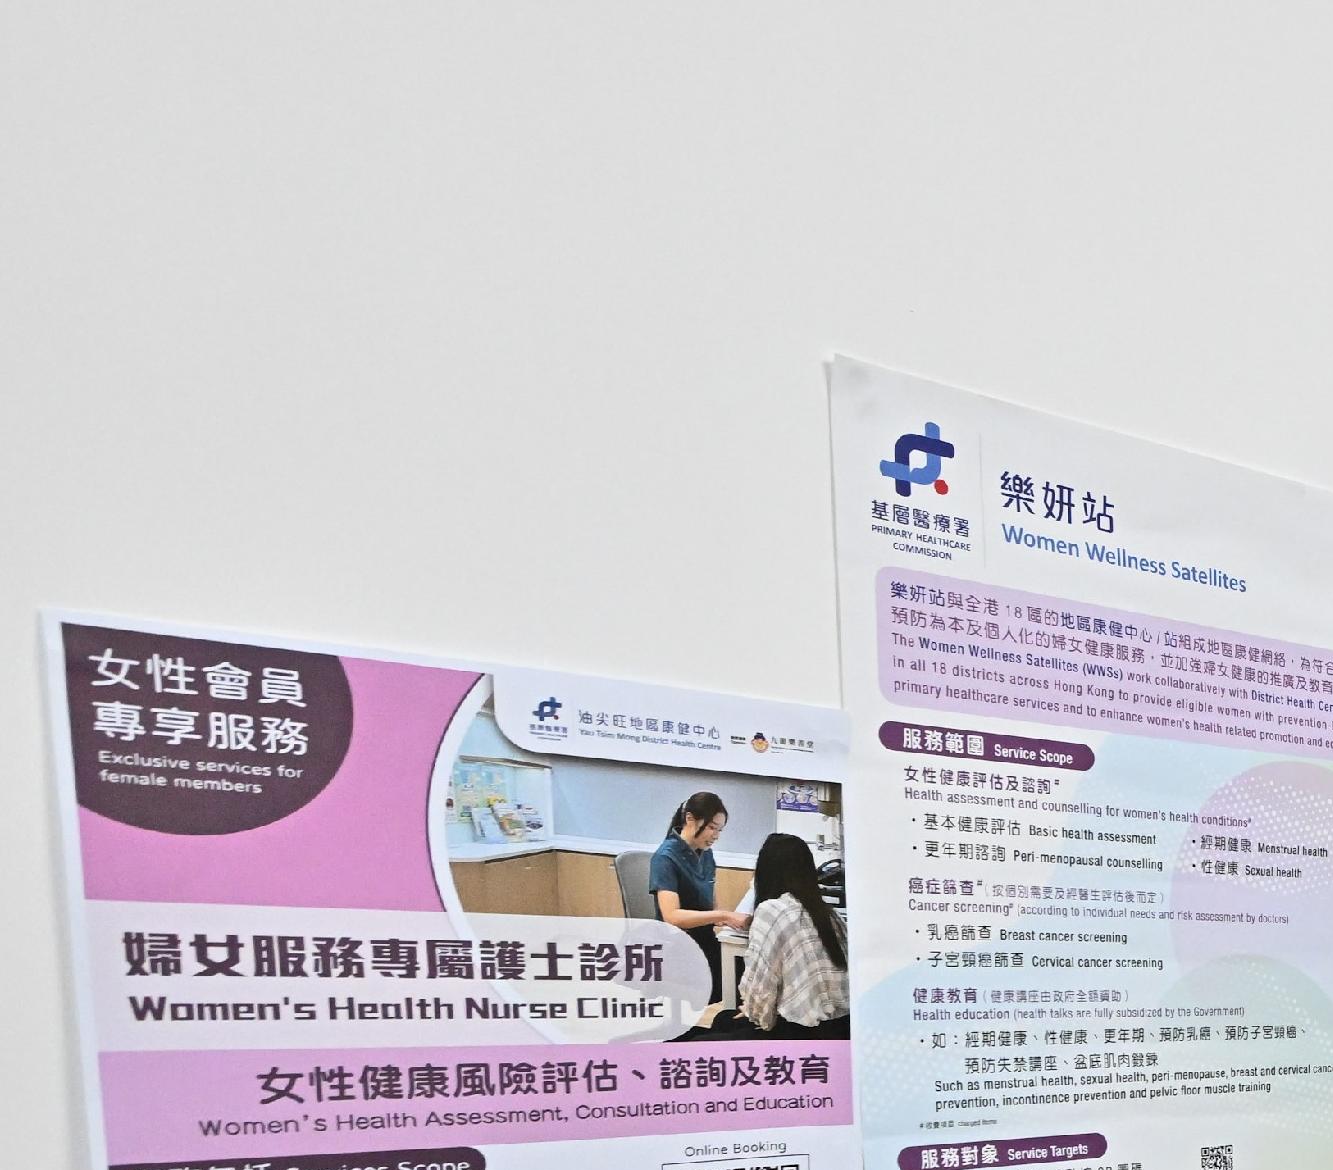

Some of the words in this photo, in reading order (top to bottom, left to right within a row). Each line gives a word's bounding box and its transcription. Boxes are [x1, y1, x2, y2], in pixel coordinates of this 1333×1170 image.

[1001, 471, 1115, 533] 樂妍站
[871, 499, 971, 538] 基層醫療署
[871, 524, 913, 540] PRIMARY
[916, 533, 971, 552] HEALTHCARE
[893, 542, 952, 560] COMMISSION
[1002, 523, 1080, 558] Women
[1085, 542, 1166, 576] Wellness
[1171, 561, 1247, 592] Satellites
[88, 648, 307, 708] 女性會員
[892, 632, 914, 647] The
[918, 636, 965, 655] Women
[968, 644, 1021, 664] Wellness
[1026, 652, 1078, 672] Satellites
[1082, 661, 1123, 681] (WWSs)
[1127, 671, 1151, 685] work
[1251, 690, 1284, 706] District
[92, 701, 309, 756] 專享服務
[903, 728, 984, 756] 服務範圍
[994, 744, 1036, 761] Service
[1040, 750, 1073, 766] Scope
[98, 749, 191, 772] Exclusive
[196, 758, 271, 777] services
[277, 765, 304, 779] for
[100, 769, 166, 787] female
[174, 776, 262, 794] members
[924, 813, 1021, 836] 基本健康評估
[1029, 824, 1058, 838] Basic
[1062, 828, 1094, 840] health
[1098, 831, 1157, 845] assessment
[925, 841, 1006, 862] 更年期諮詢
[1014, 850, 1103, 867] Peri-menopausal
[1107, 854, 1163, 872] counselling
[1302, 846, 1328, 858] health
[1201, 860, 1238, 876] 性健康
[1276, 867, 1302, 878] health
[908, 900, 950, 912] Cancer
[928, 924, 991, 941] 乳癌篩查
[1000, 929, 1035, 941] Breast
[1039, 931, 1074, 942] cancer
[1078, 932, 1127, 944] screening
[123, 931, 664, 982] 婦女服務專屬護士診所
[1032, 956, 1073, 968] Cervical
[1078, 958, 1112, 968] cancer
[1116, 958, 1163, 970] screening
[128, 996, 316, 1021] Women's
[328, 998, 453, 1020] Health
[466, 998, 567, 1020] Nurse
[578, 997, 664, 1019] Clinic
[913, 1009, 950, 1021] Health
[956, 1009, 1009, 1020] education
[256, 1054, 830, 1105] 女性健康風險評估、諮詢及教育
[198, 1114, 328, 1137] Women's
[337, 1109, 417, 1132] Health
[425, 1106, 568, 1128] Assessment,
[576, 1099, 699, 1121] Consultation
[705, 1097, 738, 1114] and
[744, 1094, 833, 1111] Education
[685, 1145, 728, 1156] Online
[733, 1141, 787, 1154] Booking
[921, 1144, 1000, 1170] 服務對象
[1008, 1147, 1047, 1161] Service
[1050, 1144, 1088, 1158] Targets
